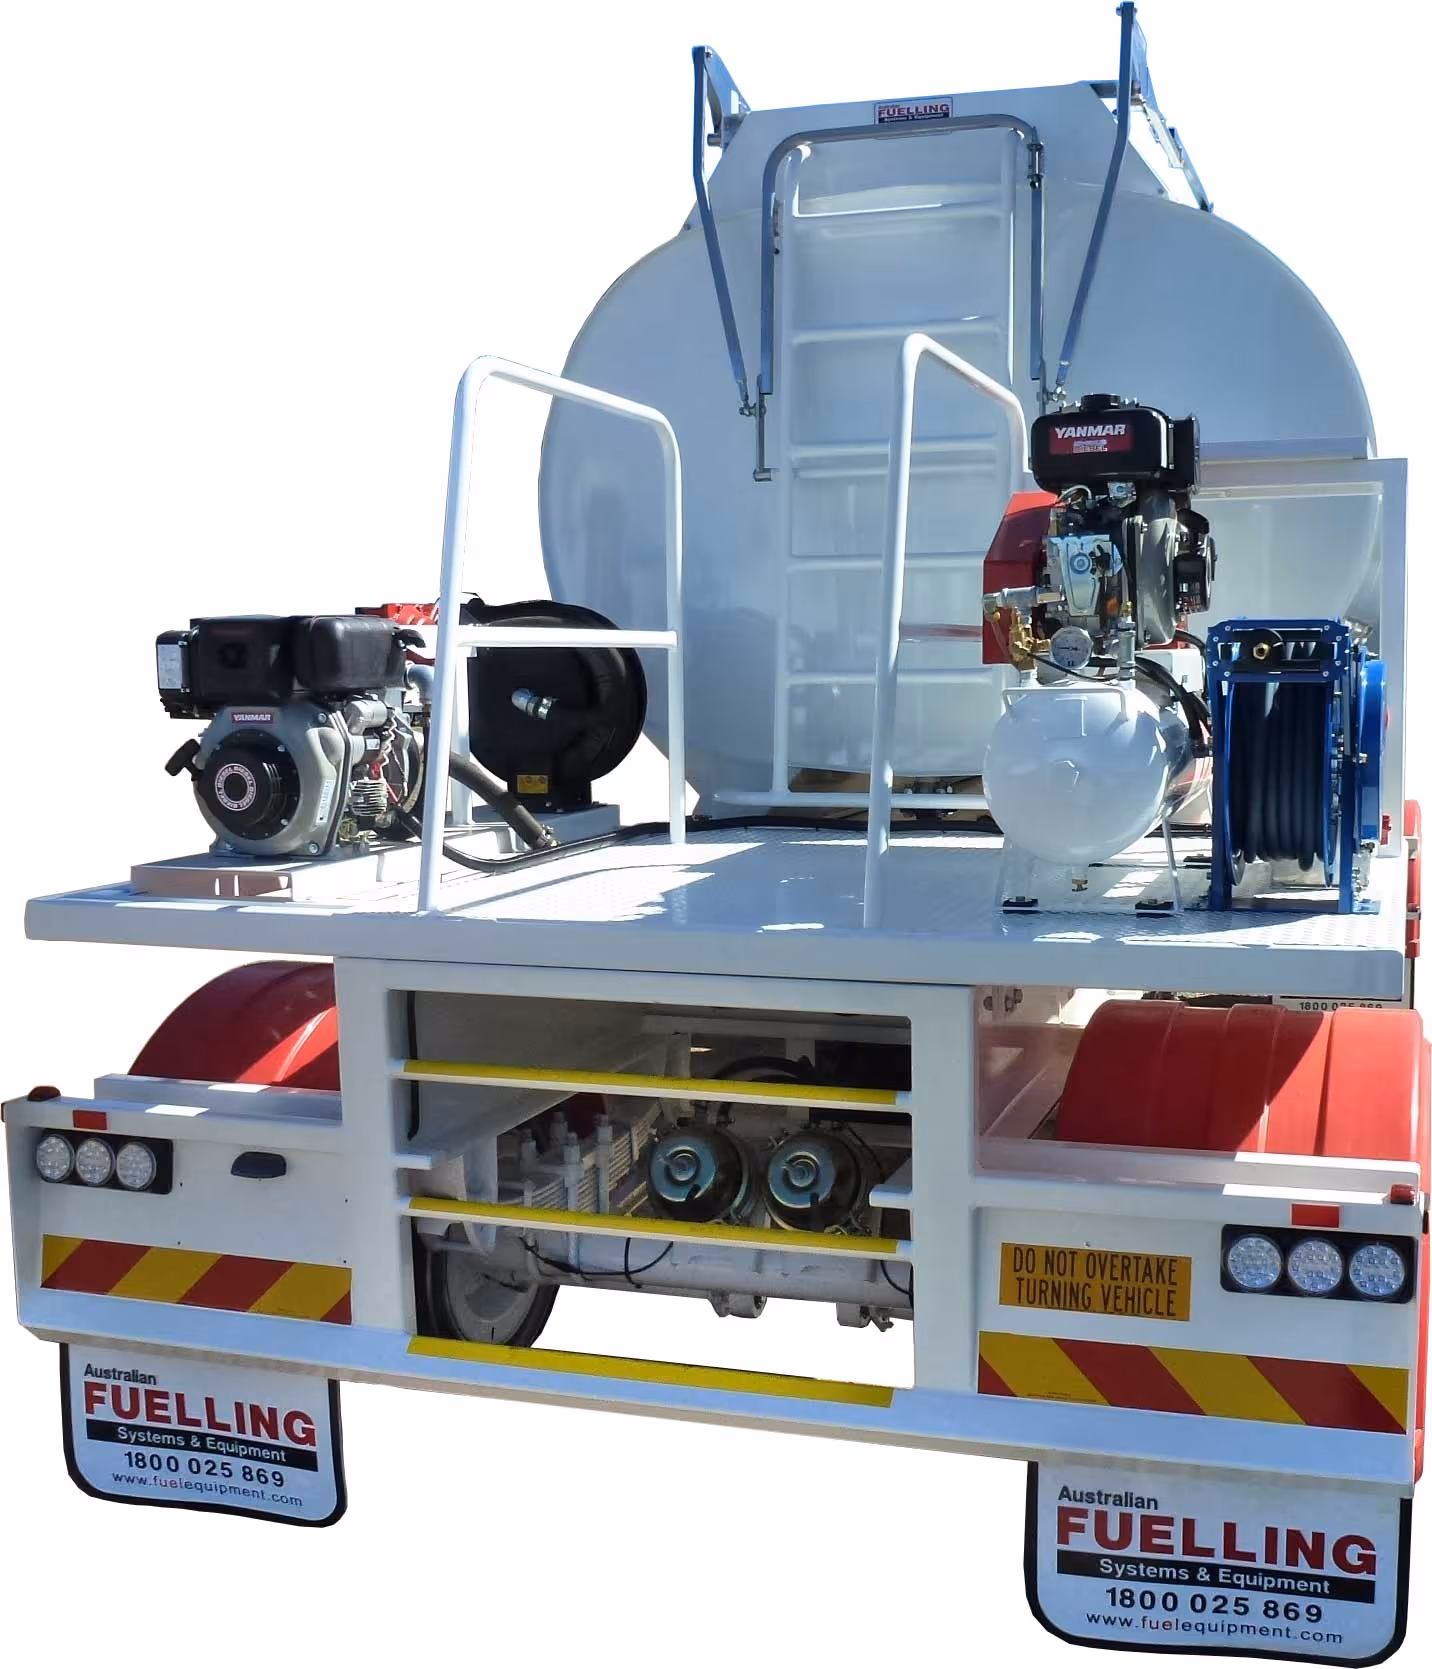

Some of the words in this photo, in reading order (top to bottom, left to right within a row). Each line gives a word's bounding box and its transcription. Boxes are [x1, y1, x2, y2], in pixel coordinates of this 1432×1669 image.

[878, 104, 949, 117] FUELLING
[1055, 424, 1126, 438] YANMAR
[1299, 1002, 1327, 1011] 1800
[1013, 1246, 1036, 1273] DO
[1044, 1249, 1078, 1277] NOT
[1086, 1252, 1178, 1286] OVERTAKE
[1016, 1277, 1092, 1310] TURNING
[1101, 1284, 1176, 1317] VEHICLE
[84, 1363, 157, 1386] Australian
[84, 1380, 317, 1447] FUELLING
[117, 1426, 185, 1447] Systems
[191, 1435, 201, 1448] &
[207, 1437, 287, 1462] Equipment
[124, 1451, 179, 1473] 1800
[188, 1458, 233, 1478] 025
[242, 1465, 285, 1488] 869
[112, 1471, 303, 1507] www.fuelequipment.com
[1057, 1485, 1159, 1511] Australian
[1057, 1505, 1377, 1576] FUELLING
[1099, 1558, 1189, 1581] Systems
[1196, 1566, 1211, 1582] &
[1218, 1568, 1331, 1595] Equipment
[1105, 1587, 1179, 1612] 1800
[1190, 1593, 1250, 1616] 025
[1262, 1599, 1323, 1623] 869
[1086, 1612, 1343, 1645] www.fuelequipment.com
